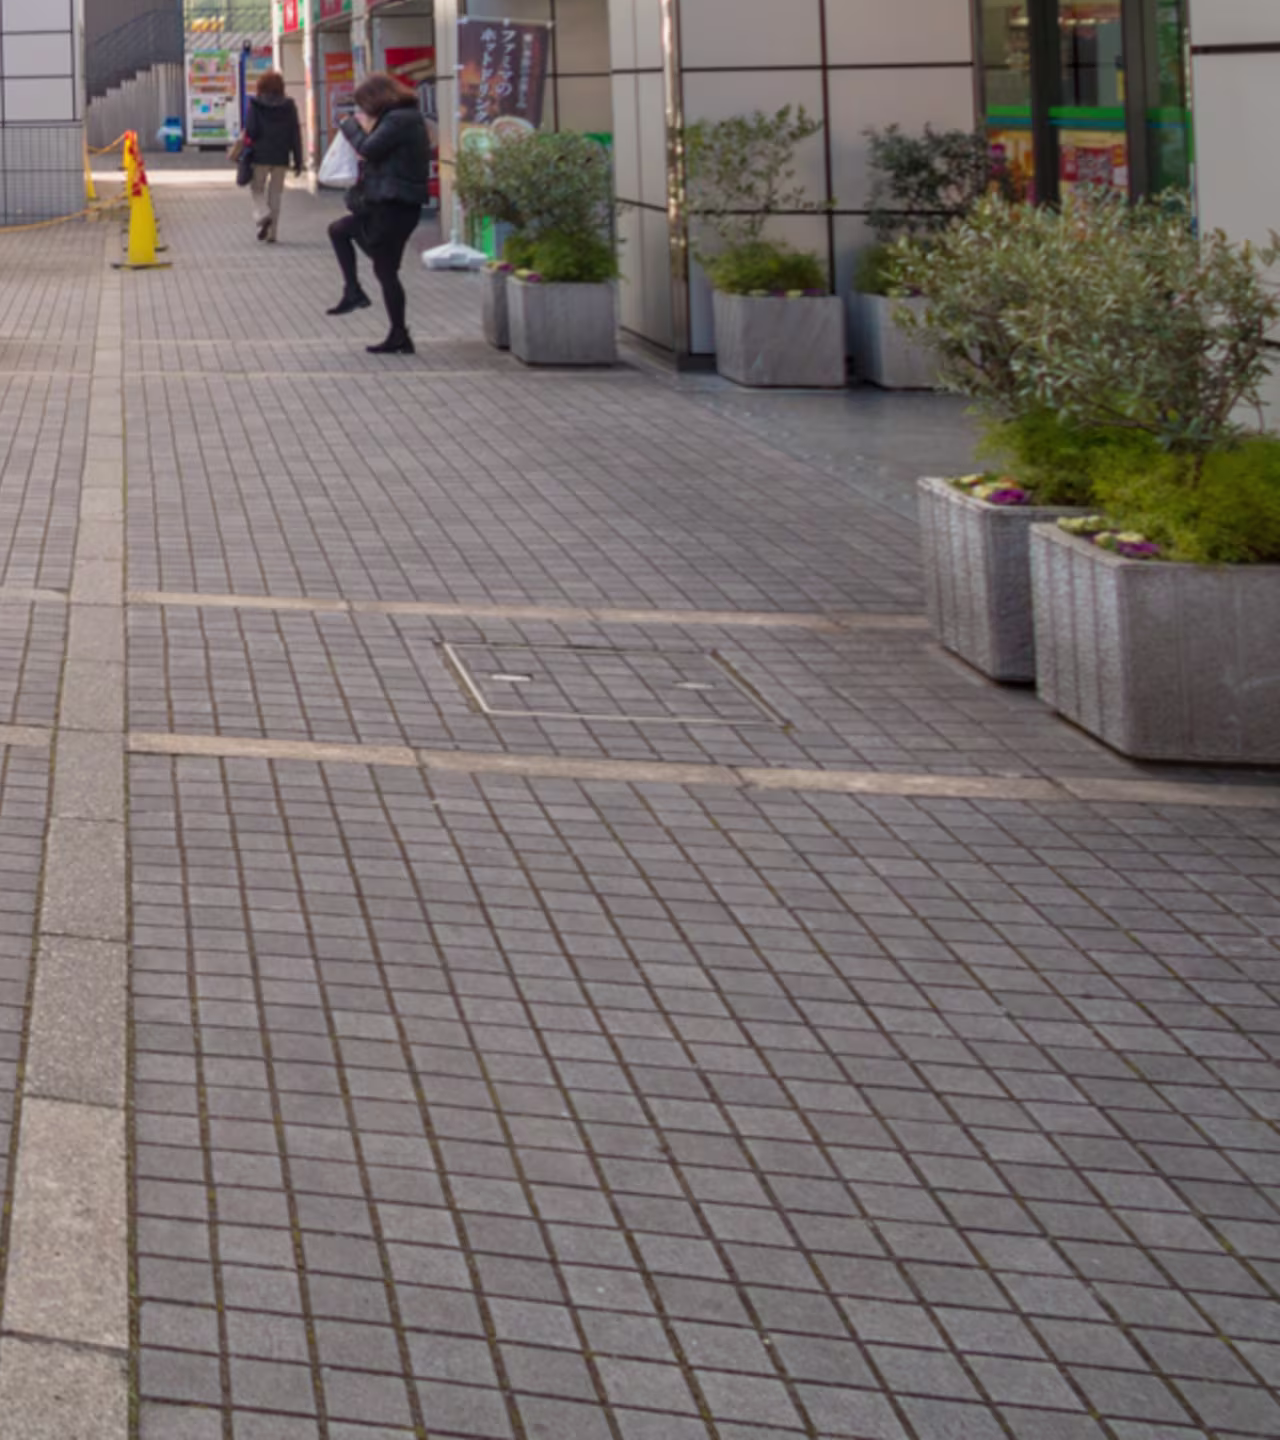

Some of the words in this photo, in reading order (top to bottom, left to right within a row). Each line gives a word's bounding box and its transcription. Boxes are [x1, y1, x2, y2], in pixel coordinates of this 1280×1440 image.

[496, 29, 516, 97] ファミマの
